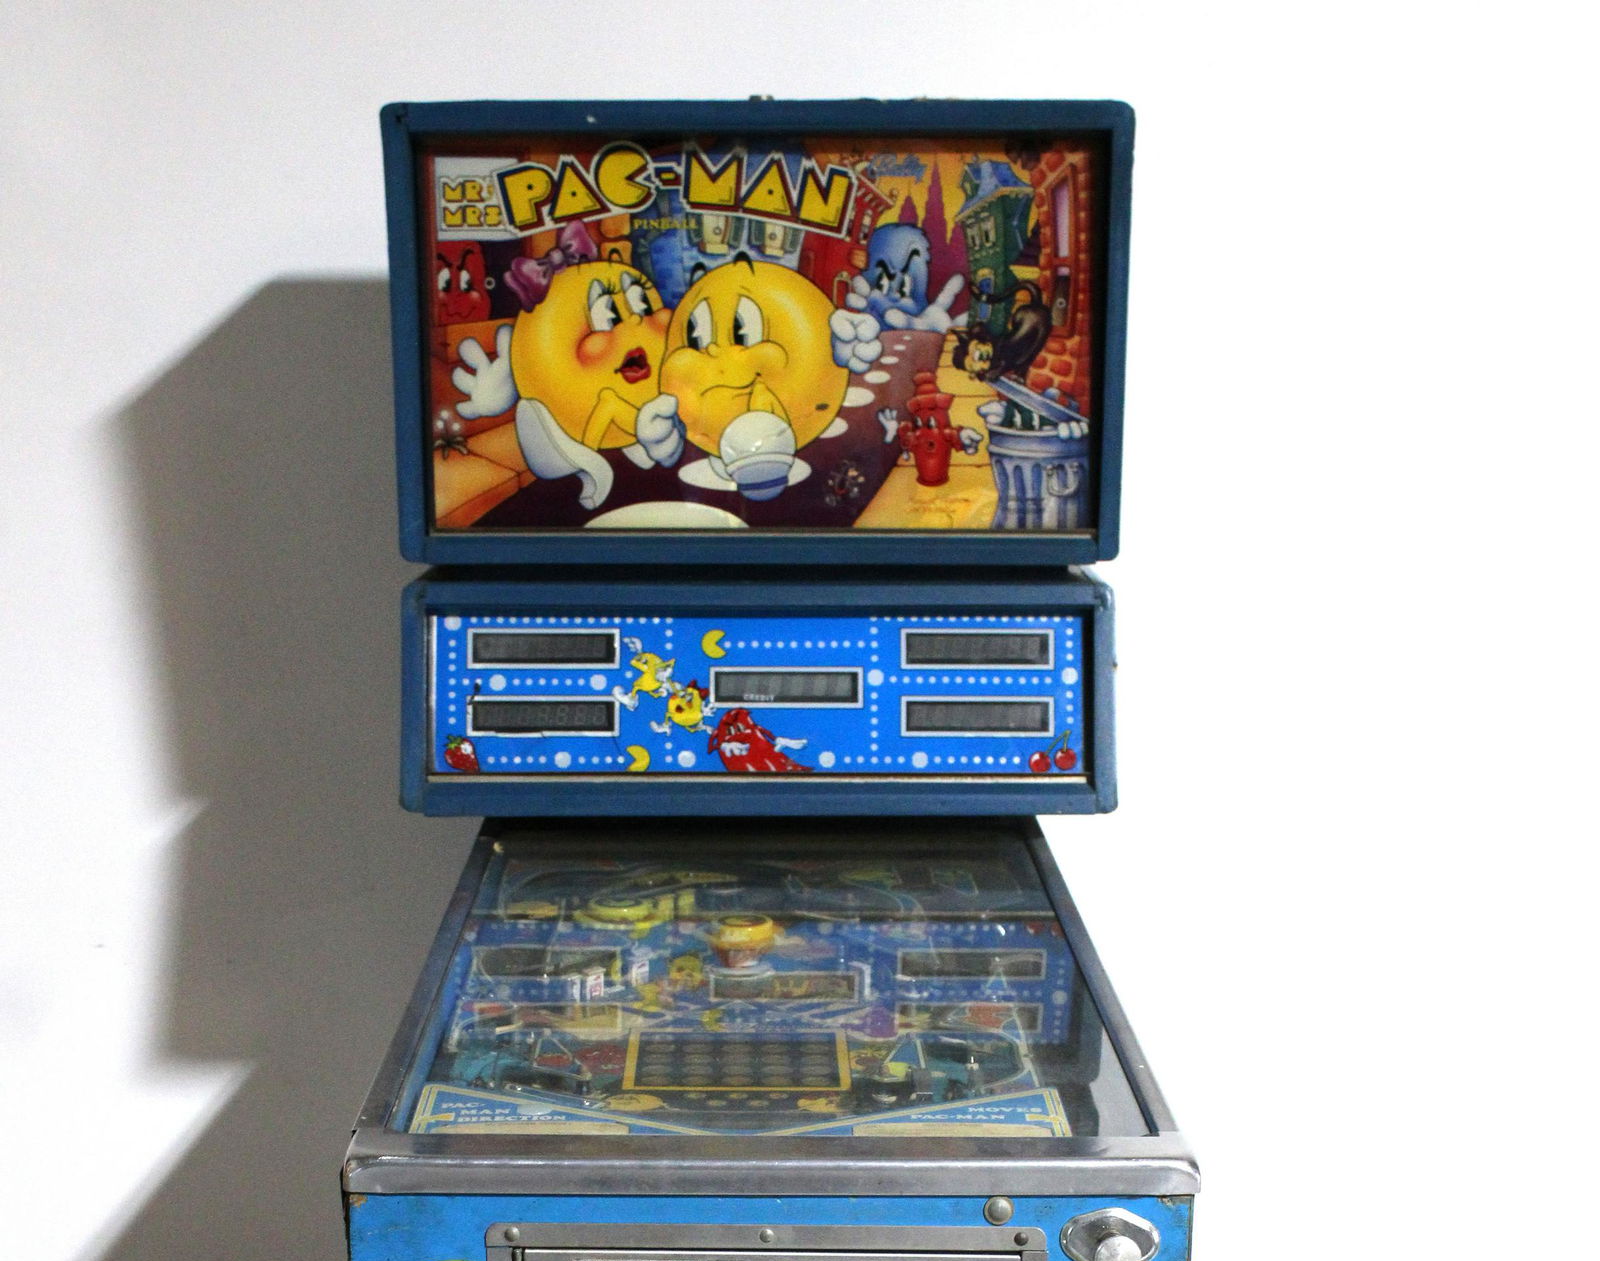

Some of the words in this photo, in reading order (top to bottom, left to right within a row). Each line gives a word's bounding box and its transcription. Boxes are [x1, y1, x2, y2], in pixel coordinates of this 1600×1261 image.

[442, 180, 484, 203] MR
[495, 143, 857, 237] PAC-MAN
[442, 205, 502, 227] MRS
[633, 217, 699, 230] PINBALL
[457, 1115, 567, 1123] DIRECTION
